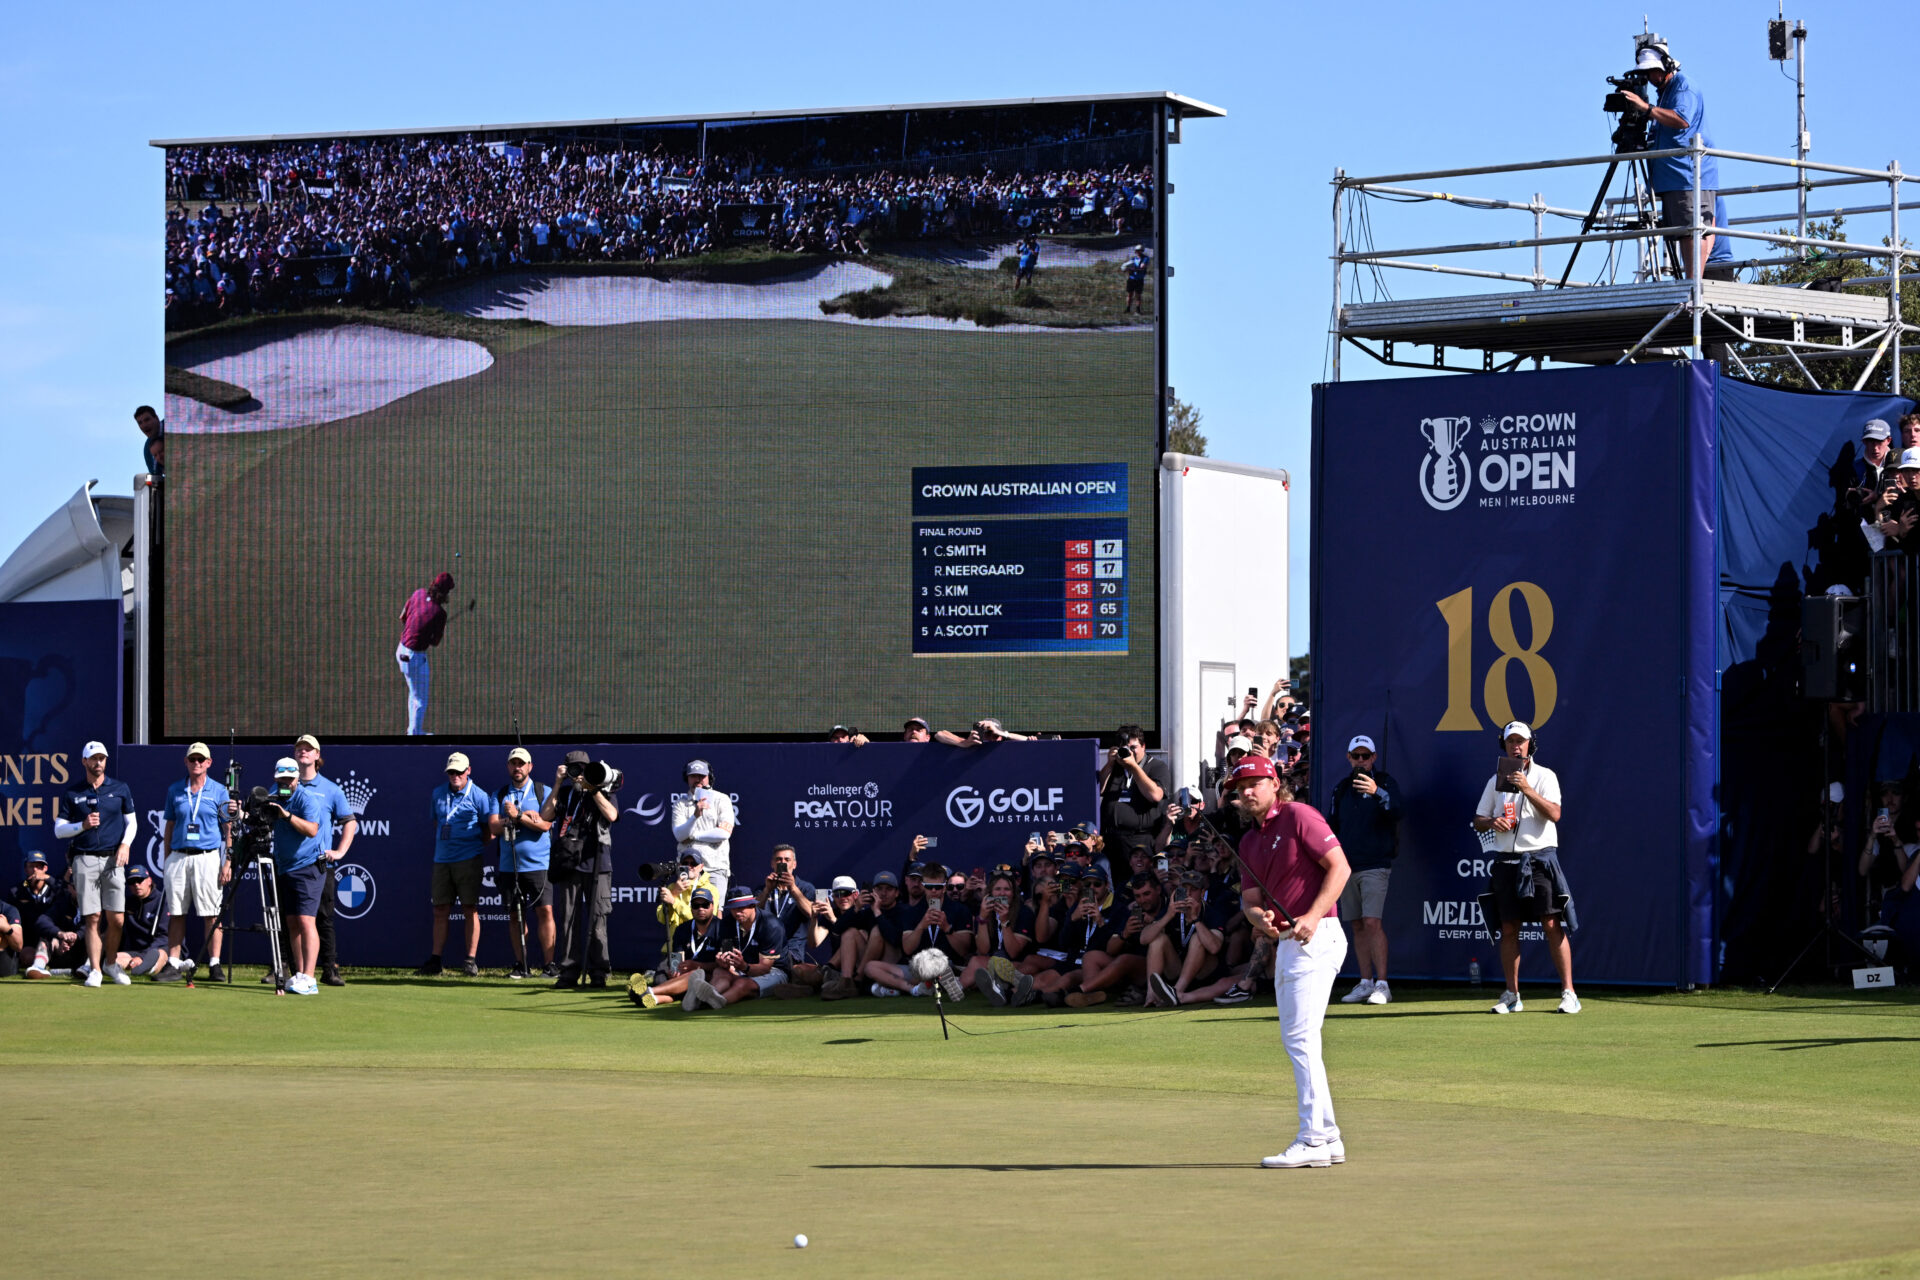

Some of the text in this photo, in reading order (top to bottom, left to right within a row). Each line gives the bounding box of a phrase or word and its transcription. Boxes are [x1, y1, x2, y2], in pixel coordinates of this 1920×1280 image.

[1500, 412, 1576, 433] CROWN
[1480, 435, 1576, 451] AUSTRALIAN
[1479, 451, 1575, 492] OPEN
[922, 481, 1116, 497] CROWN AUSTRALIAN OPEN
[1480, 494, 1575, 507] MEN MELBOURNE
[920, 527, 982, 536] FINAL ROUND
[922, 547, 927, 556] 1
[1071, 543, 1088, 554] -15
[1102, 543, 1115, 554] 17
[1071, 564, 1088, 574] -15
[1102, 563, 1115, 574] 17
[921, 587, 928, 596] 3
[1071, 583, 1088, 594] -13
[1100, 583, 1116, 594] 70
[921, 607, 928, 616] 4
[1071, 603, 1088, 614] -12
[1100, 603, 1117, 614] 65
[921, 627, 928, 636] 5
[1073, 624, 1088, 634] -11
[1100, 624, 1116, 634] 70
[1435, 581, 1557, 731] 18
[0, 753, 70, 785] NTS
[808, 784, 862, 797] challenger
[988, 788, 1064, 813] GOLF
[0, 797, 43, 826] KE
[1504, 802, 1514, 824] EDIA
[795, 820, 892, 828] AUSTRALASIA
[989, 814, 1064, 823] AUSTRALIA
[334, 866, 370, 882] BMW
[1439, 930, 1472, 939] EVERY
[1867, 974, 1881, 983] DZ
